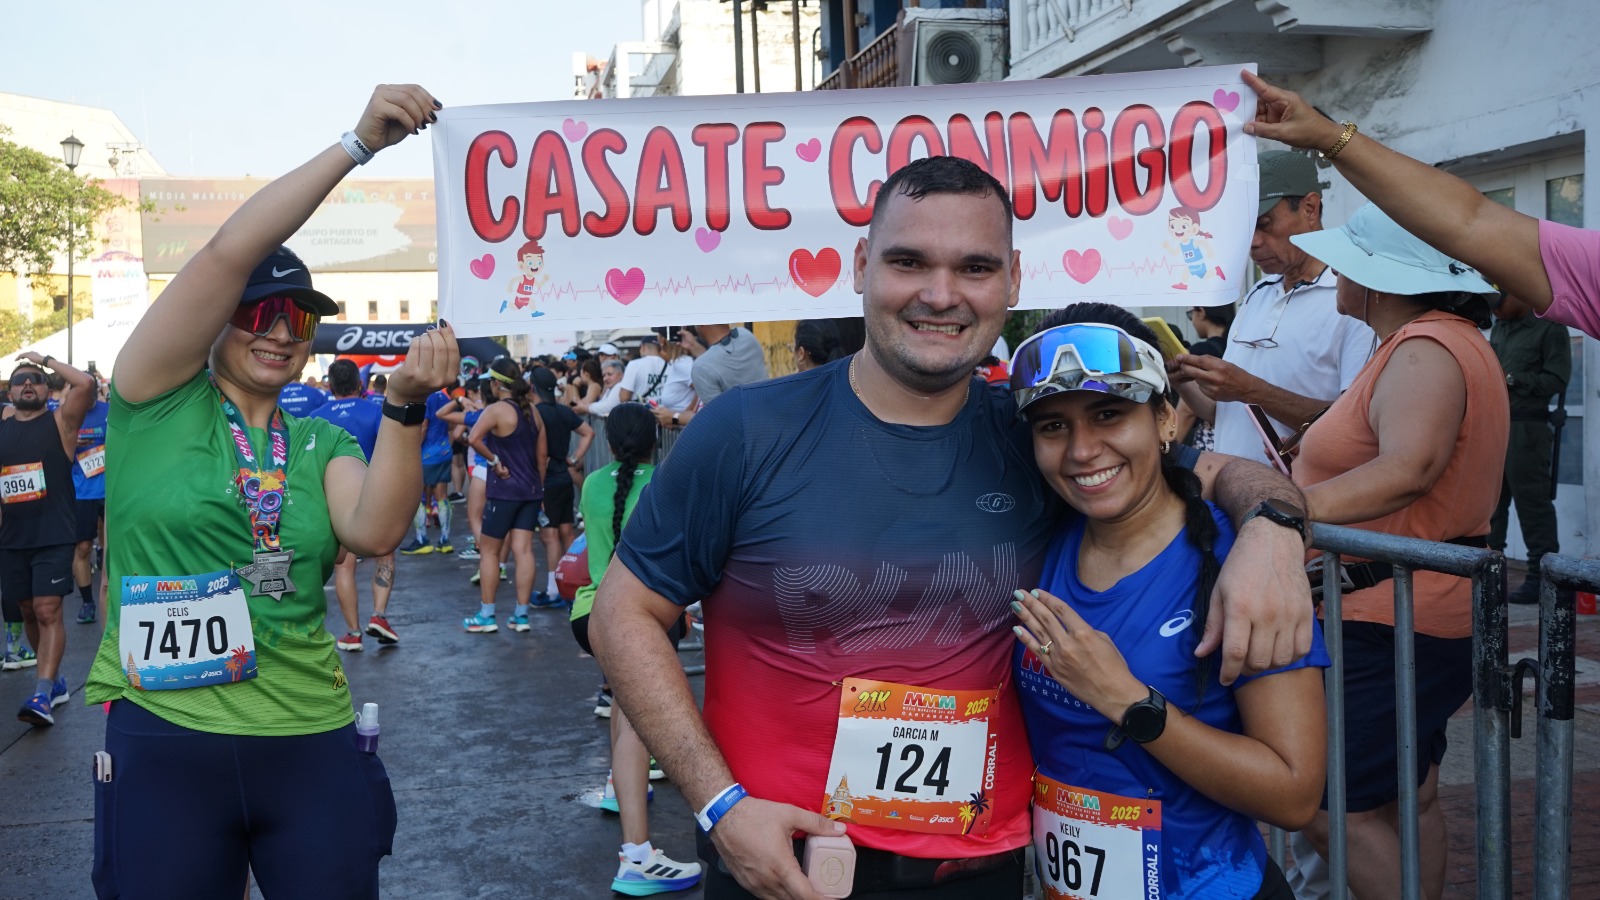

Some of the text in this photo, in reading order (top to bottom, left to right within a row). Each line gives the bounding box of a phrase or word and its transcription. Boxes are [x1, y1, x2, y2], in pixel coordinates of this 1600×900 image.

[464, 121, 792, 243] CASATE
[149, 191, 186, 200] MEDIA
[297, 229, 379, 237] GRUPO PUERTO DE
[311, 237, 365, 246] CARTAGENA
[362, 330, 415, 348] asics
[4, 477, 35, 494] 3994
[130, 582, 149, 601] 10K
[156, 579, 198, 592] MMM
[206, 575, 230, 594] 2025
[167, 606, 190, 617] CELIS
[138, 615, 229, 661] 7470
[1020, 670, 1041, 683] MEDIA
[854, 689, 892, 713] 21K
[902, 691, 957, 710] MMM
[964, 697, 990, 716] 2025
[901, 711, 955, 719] CARTAGENA
[893, 726, 939, 741] GARCIA M
[875, 742, 952, 796] 124
[985, 742, 998, 790] CORRAL
[1056, 787, 1101, 811] MMM
[1110, 805, 1141, 820] 2025
[1060, 822, 1080, 838] KEILY
[1147, 844, 1158, 852] 2
[1046, 831, 1106, 897] 967
